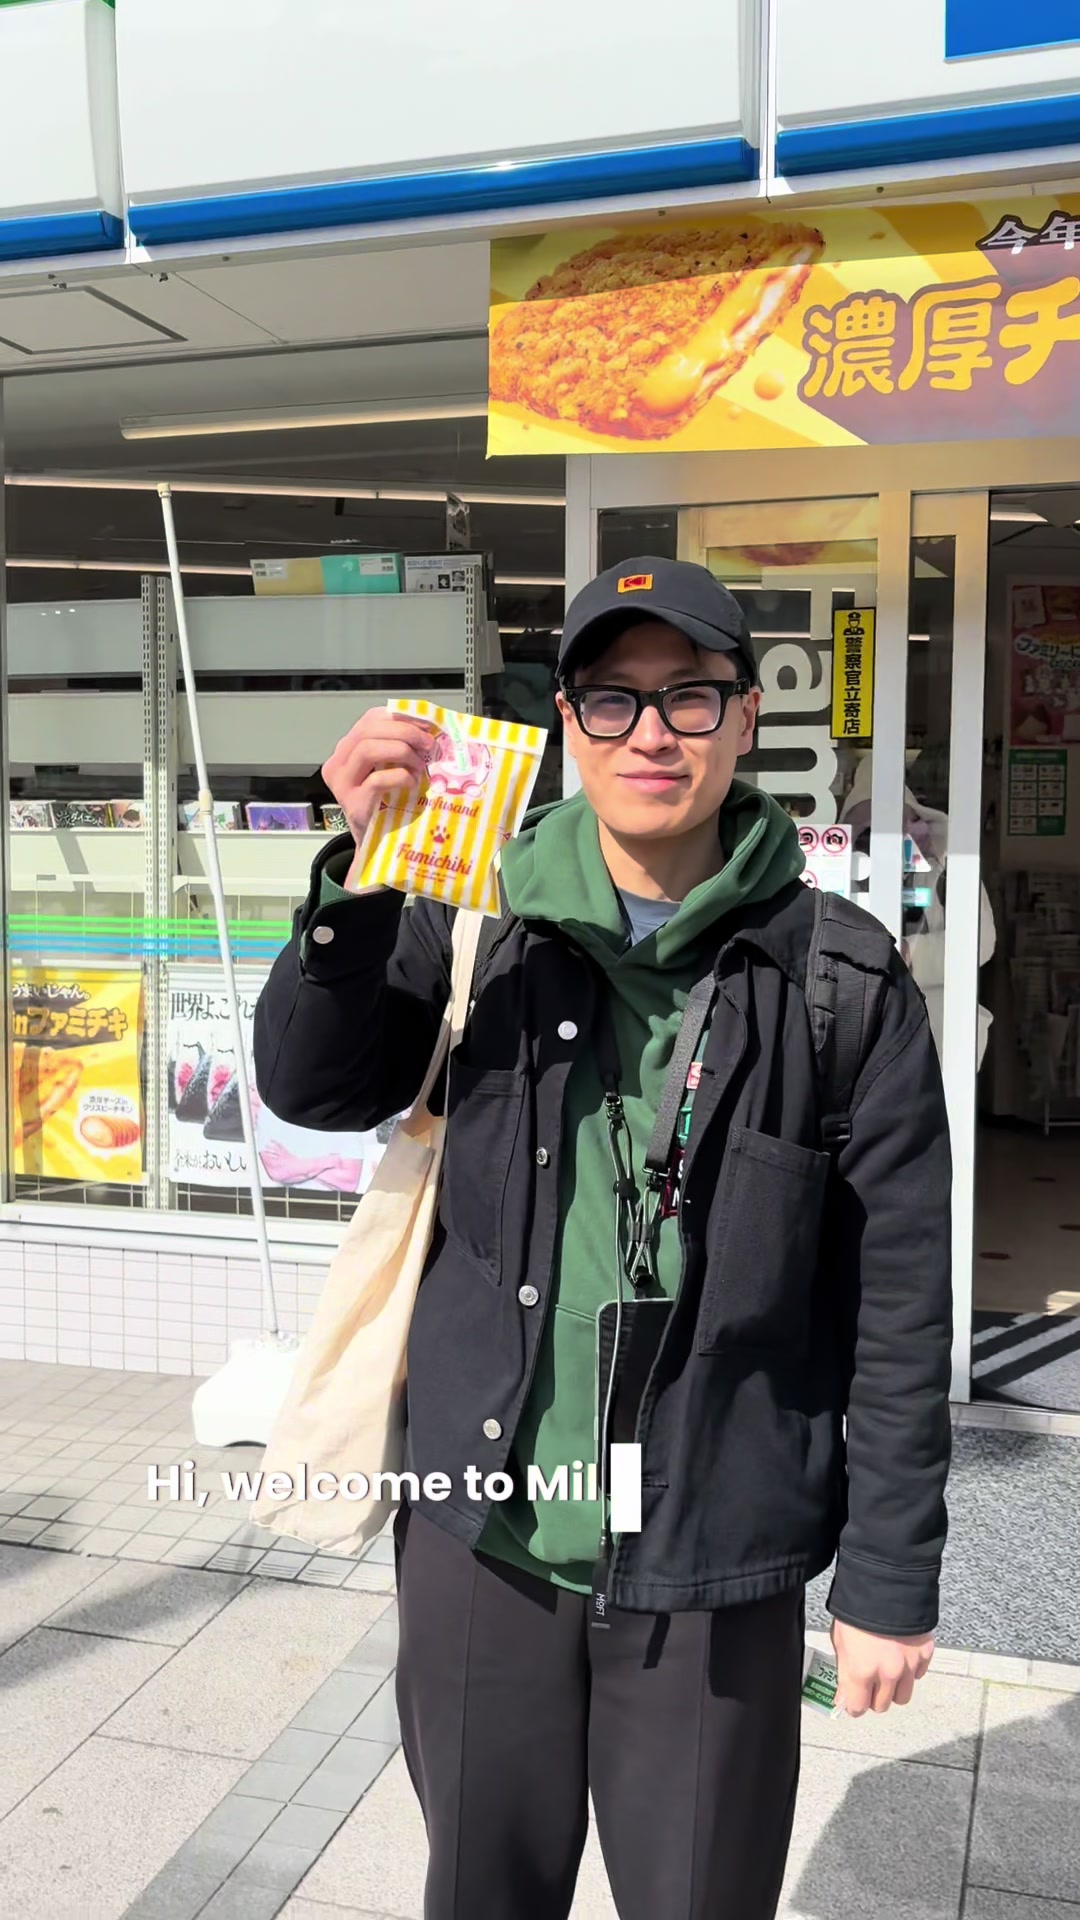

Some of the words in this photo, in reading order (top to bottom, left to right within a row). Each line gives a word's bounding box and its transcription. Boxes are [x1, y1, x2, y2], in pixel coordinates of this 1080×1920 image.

[979, 216, 1080, 255] 今年
[803, 276, 1080, 398] 濃厚チ
[843, 637, 863, 735] 警察官立寄店
[397, 843, 474, 876] Famichiki
